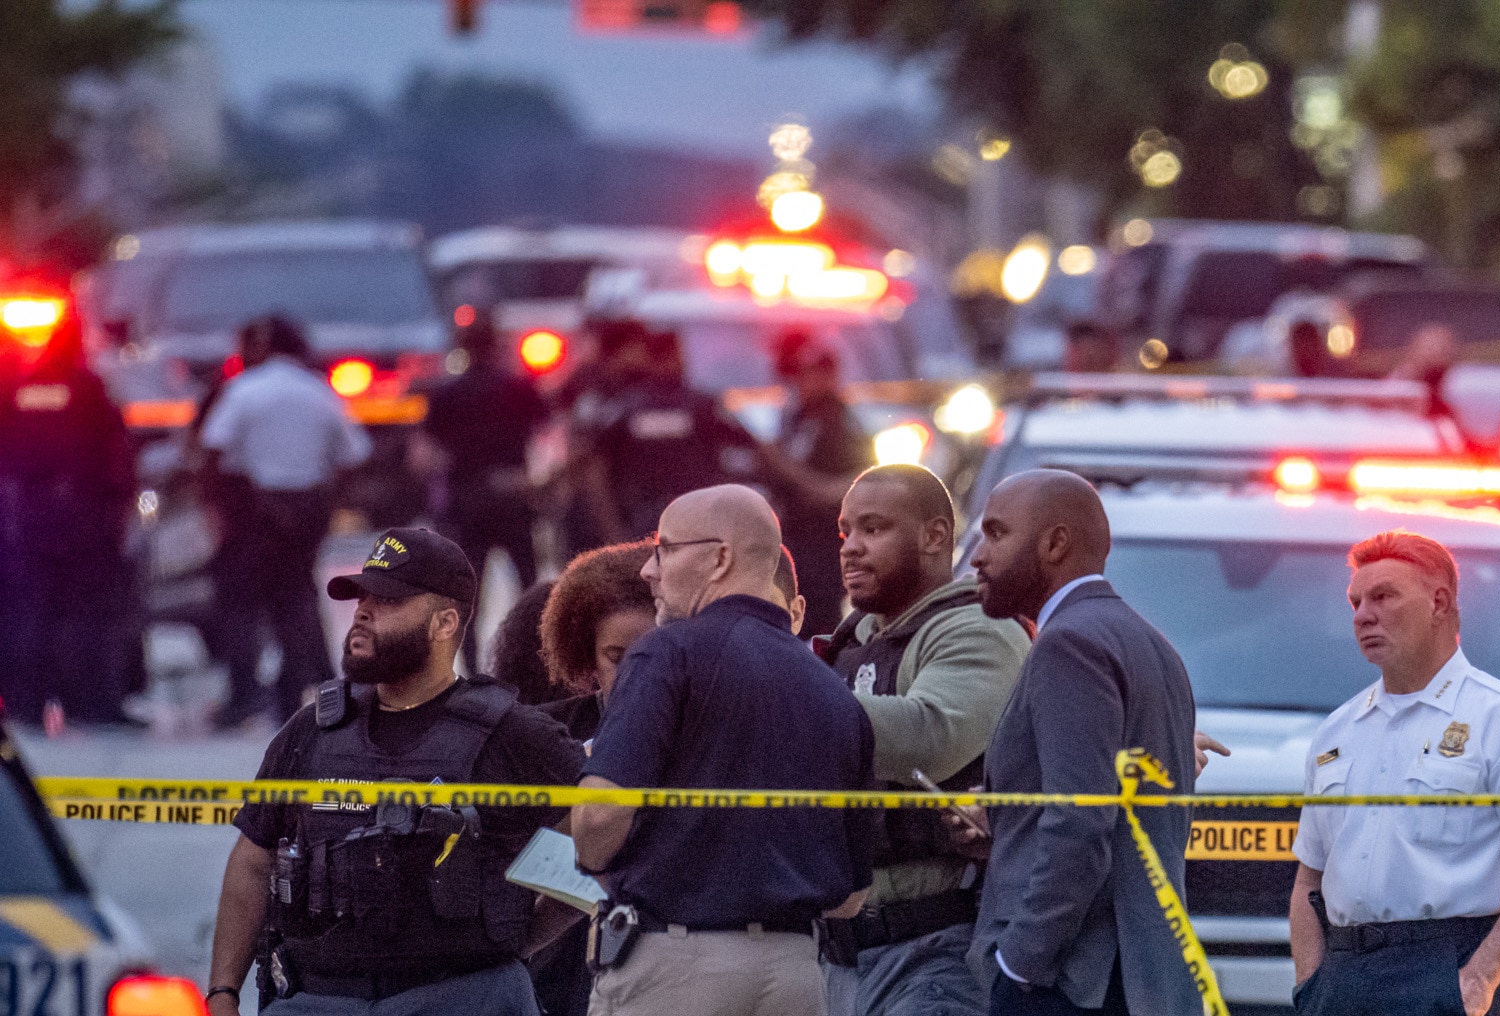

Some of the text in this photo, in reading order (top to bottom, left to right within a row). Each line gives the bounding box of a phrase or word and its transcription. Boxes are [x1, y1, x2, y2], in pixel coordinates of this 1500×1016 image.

[383, 536, 407, 554] ARMY
[65, 803, 146, 823] POLICE
[155, 805, 203, 824] LINE
[1189, 827, 1297, 851] POLICE LI
